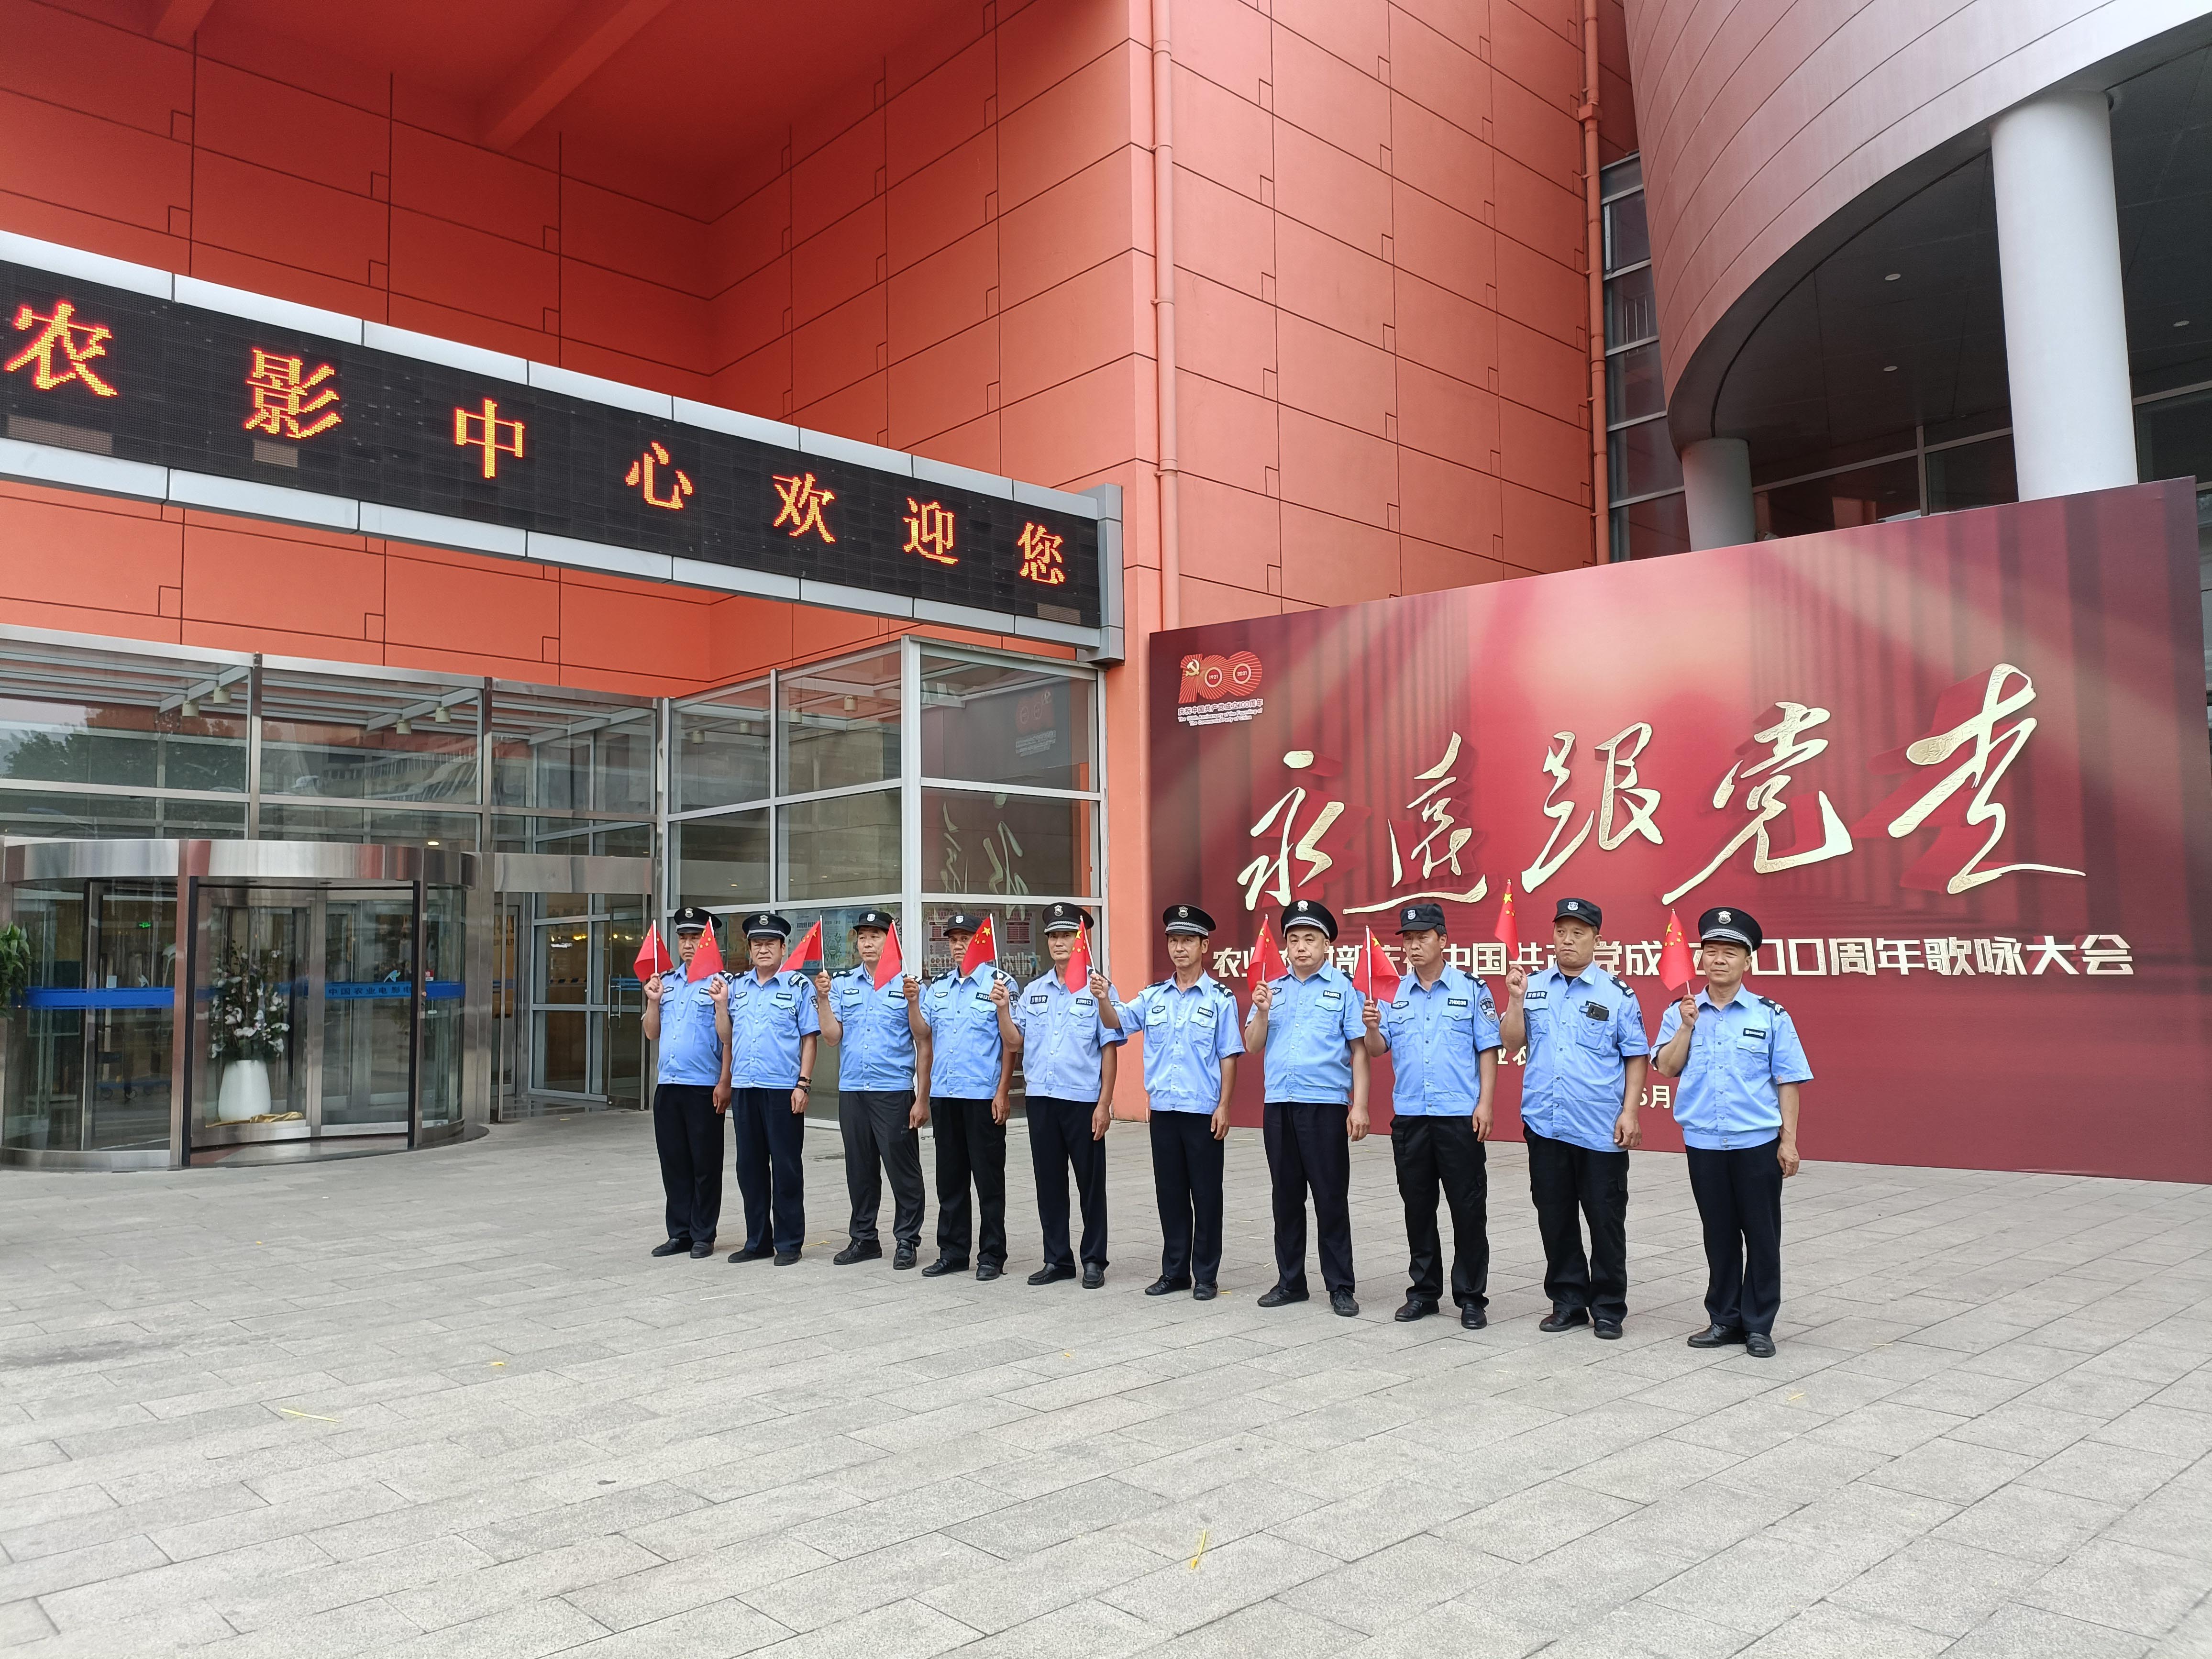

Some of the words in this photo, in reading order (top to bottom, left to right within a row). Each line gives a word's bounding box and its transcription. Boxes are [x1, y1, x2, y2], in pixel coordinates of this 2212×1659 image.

[4, 300, 1065, 585] 农影中心欢迎您
[1178, 699, 1263, 716] 庆祝中国共产党成立100周年
